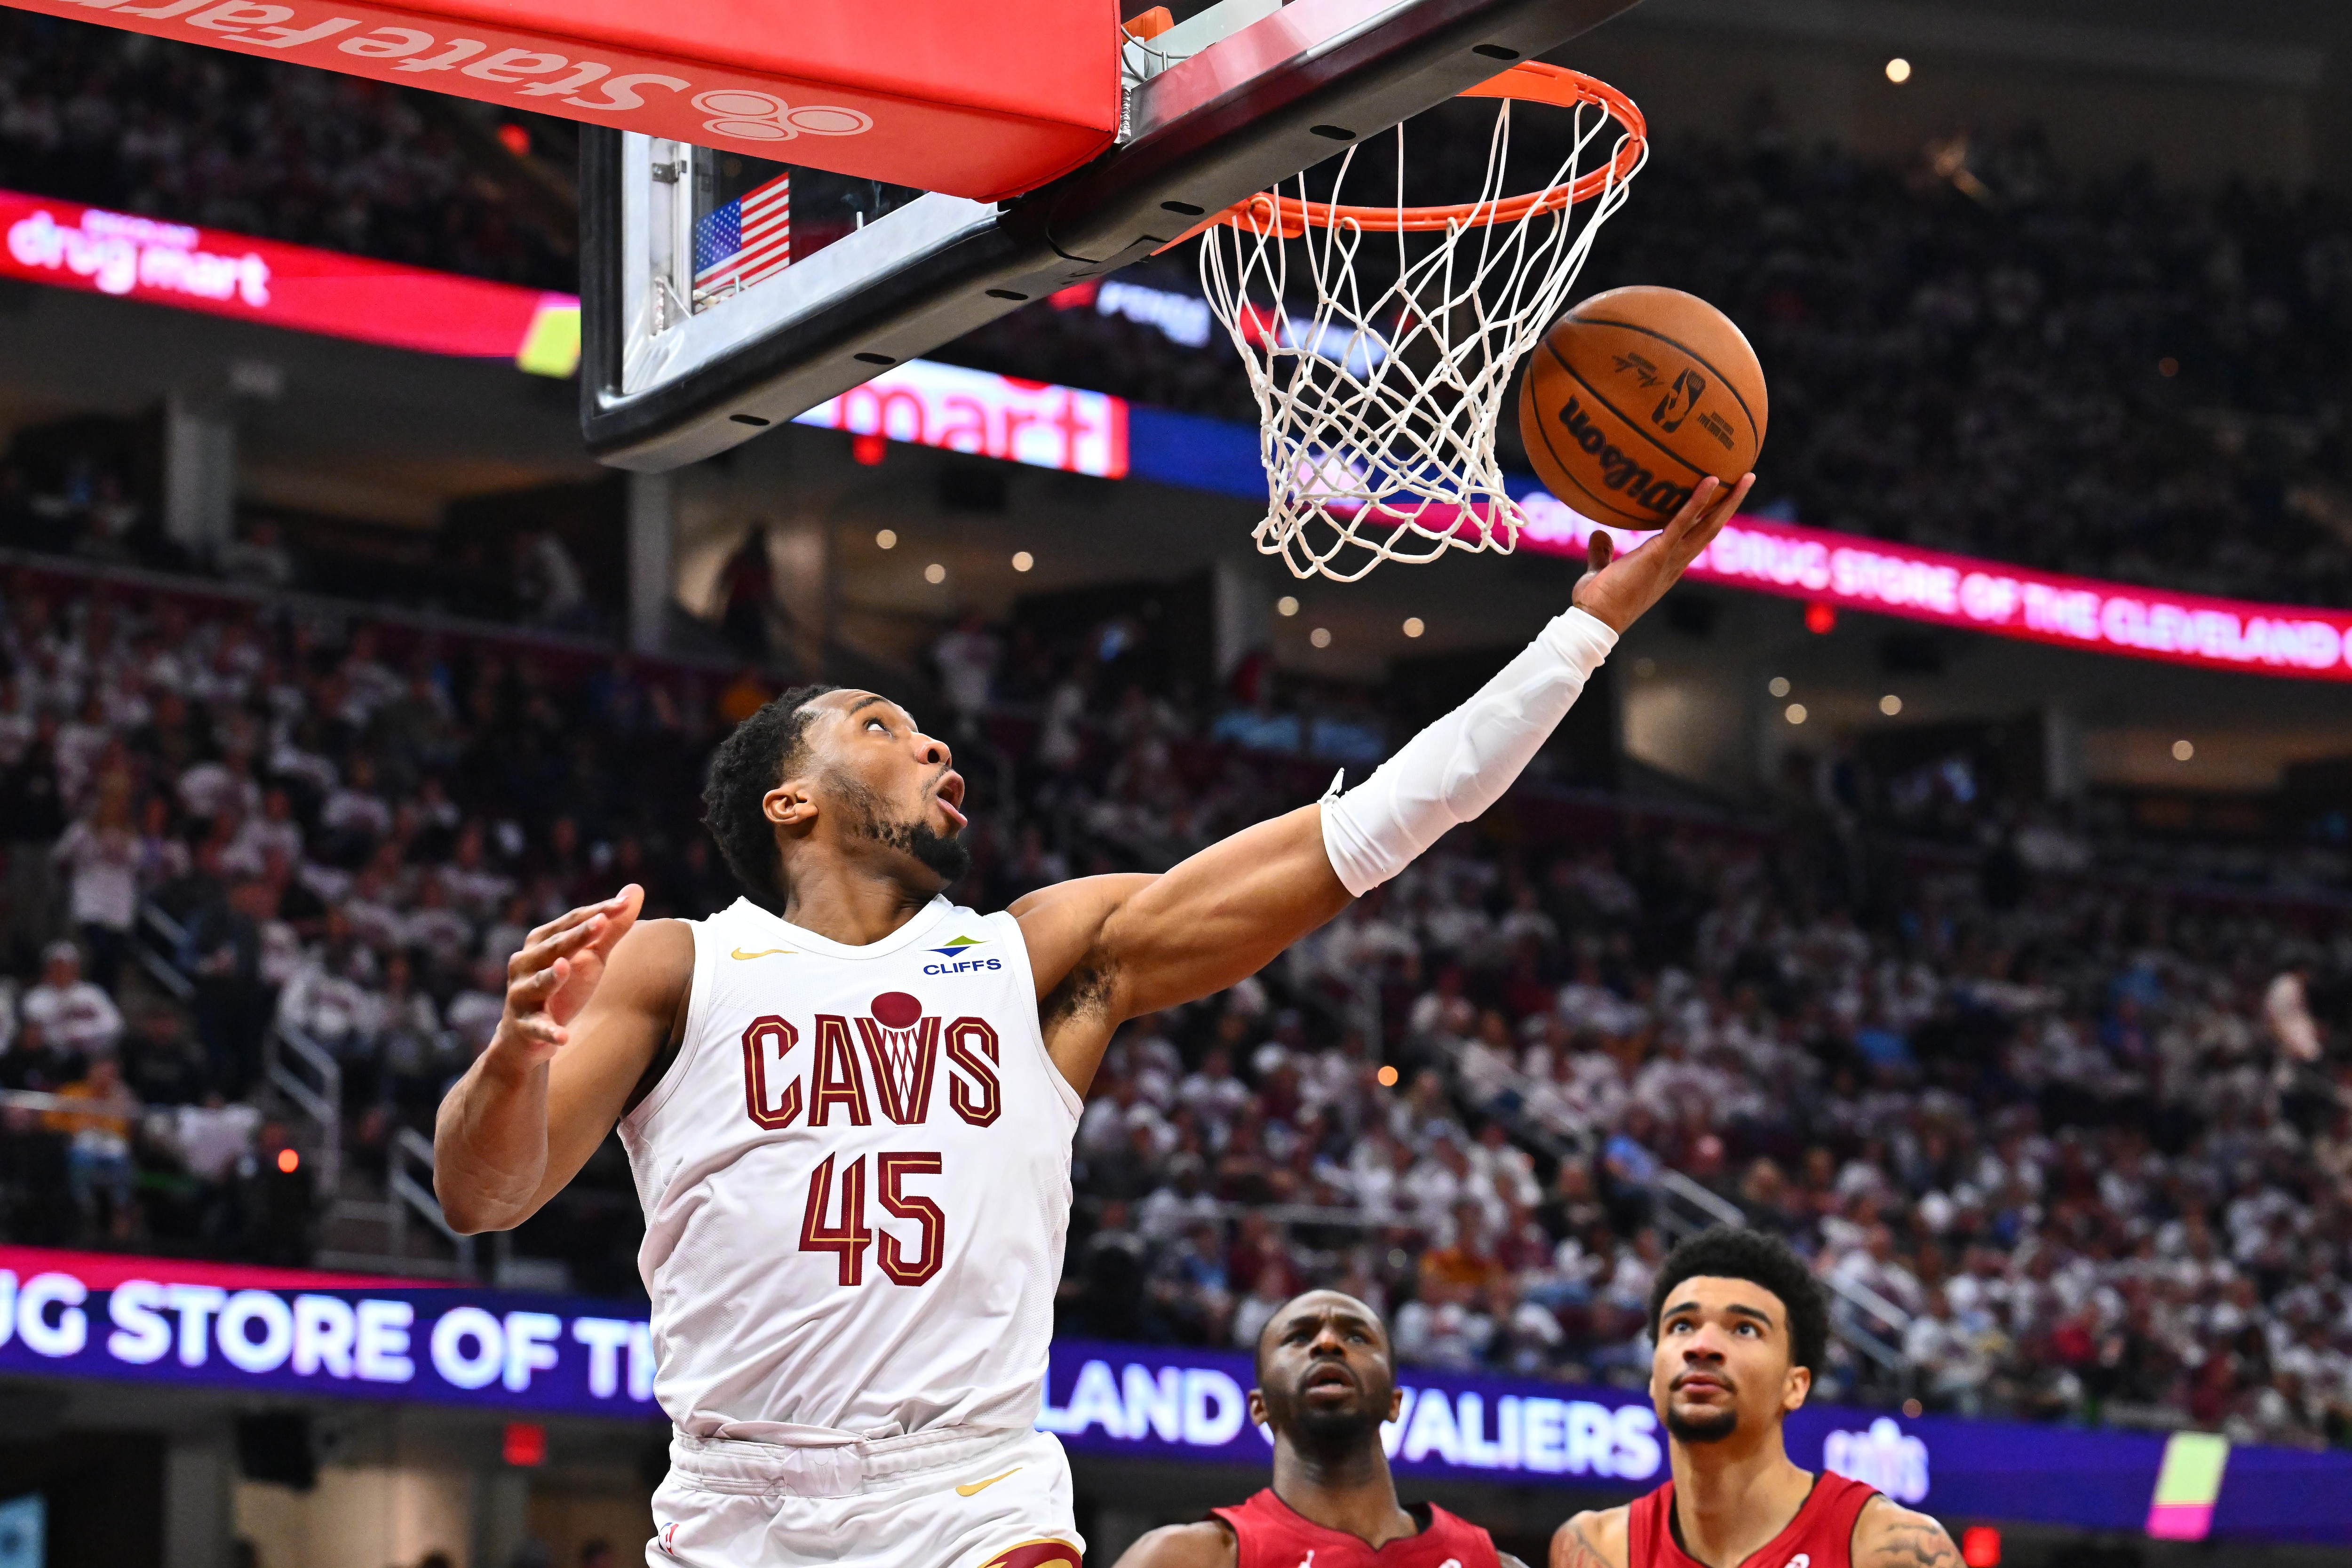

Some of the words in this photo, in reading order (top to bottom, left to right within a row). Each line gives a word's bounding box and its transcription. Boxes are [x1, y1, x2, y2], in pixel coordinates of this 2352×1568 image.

[1558, 395, 1693, 515] Wilson
[922, 958, 1002, 976] CLIFFS
[741, 1011, 1002, 1131] CAVS
[798, 1151, 946, 1288] 45
[107, 1279, 415, 1384] STORE
[430, 1306, 563, 1393] OF
